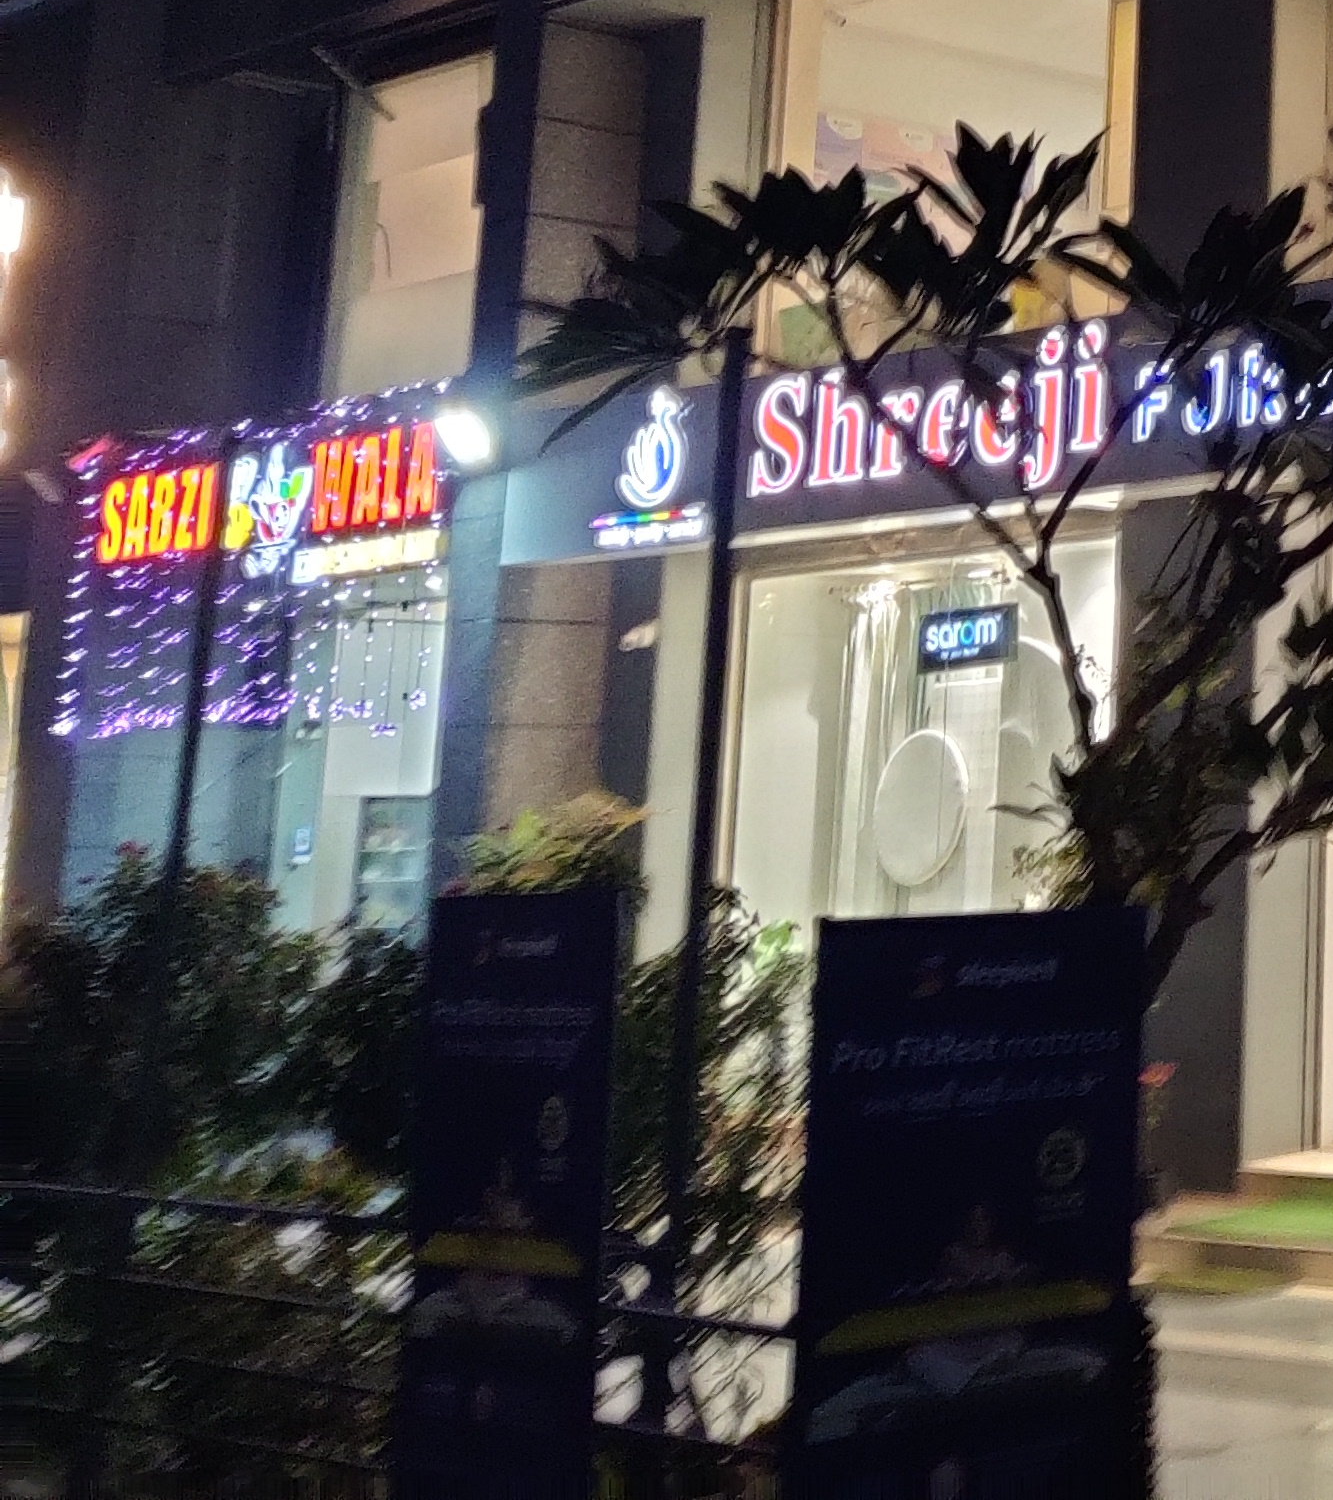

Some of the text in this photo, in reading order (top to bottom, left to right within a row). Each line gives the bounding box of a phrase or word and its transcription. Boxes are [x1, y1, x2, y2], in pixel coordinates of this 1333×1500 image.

[747, 318, 1108, 499] Shreeji
[97, 460, 223, 564] SABZI
[312, 420, 438, 534] WALA
[925, 616, 997, 652] sarom
